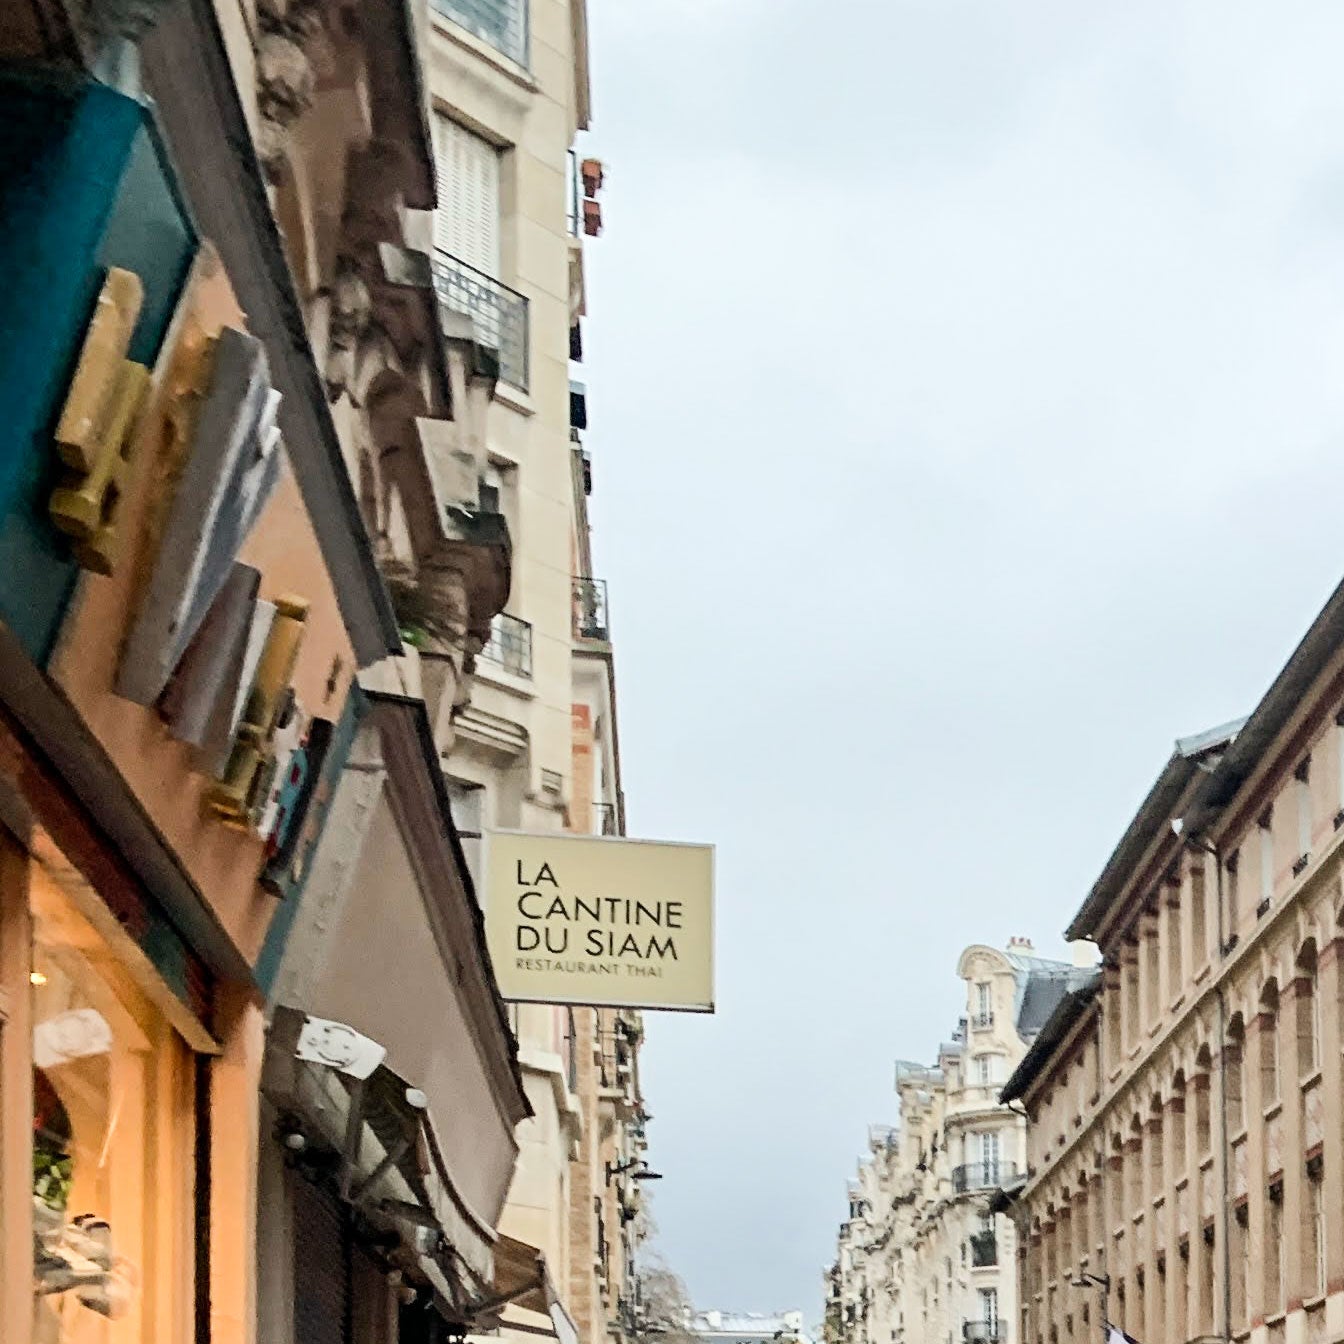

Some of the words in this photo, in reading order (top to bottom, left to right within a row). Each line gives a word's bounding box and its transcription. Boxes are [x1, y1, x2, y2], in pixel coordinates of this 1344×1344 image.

[516, 859, 559, 888] LA
[517, 891, 683, 929] CANTINE
[516, 925, 568, 954] DU
[585, 929, 678, 960] SIAM
[515, 957, 619, 976] RESTAURANT
